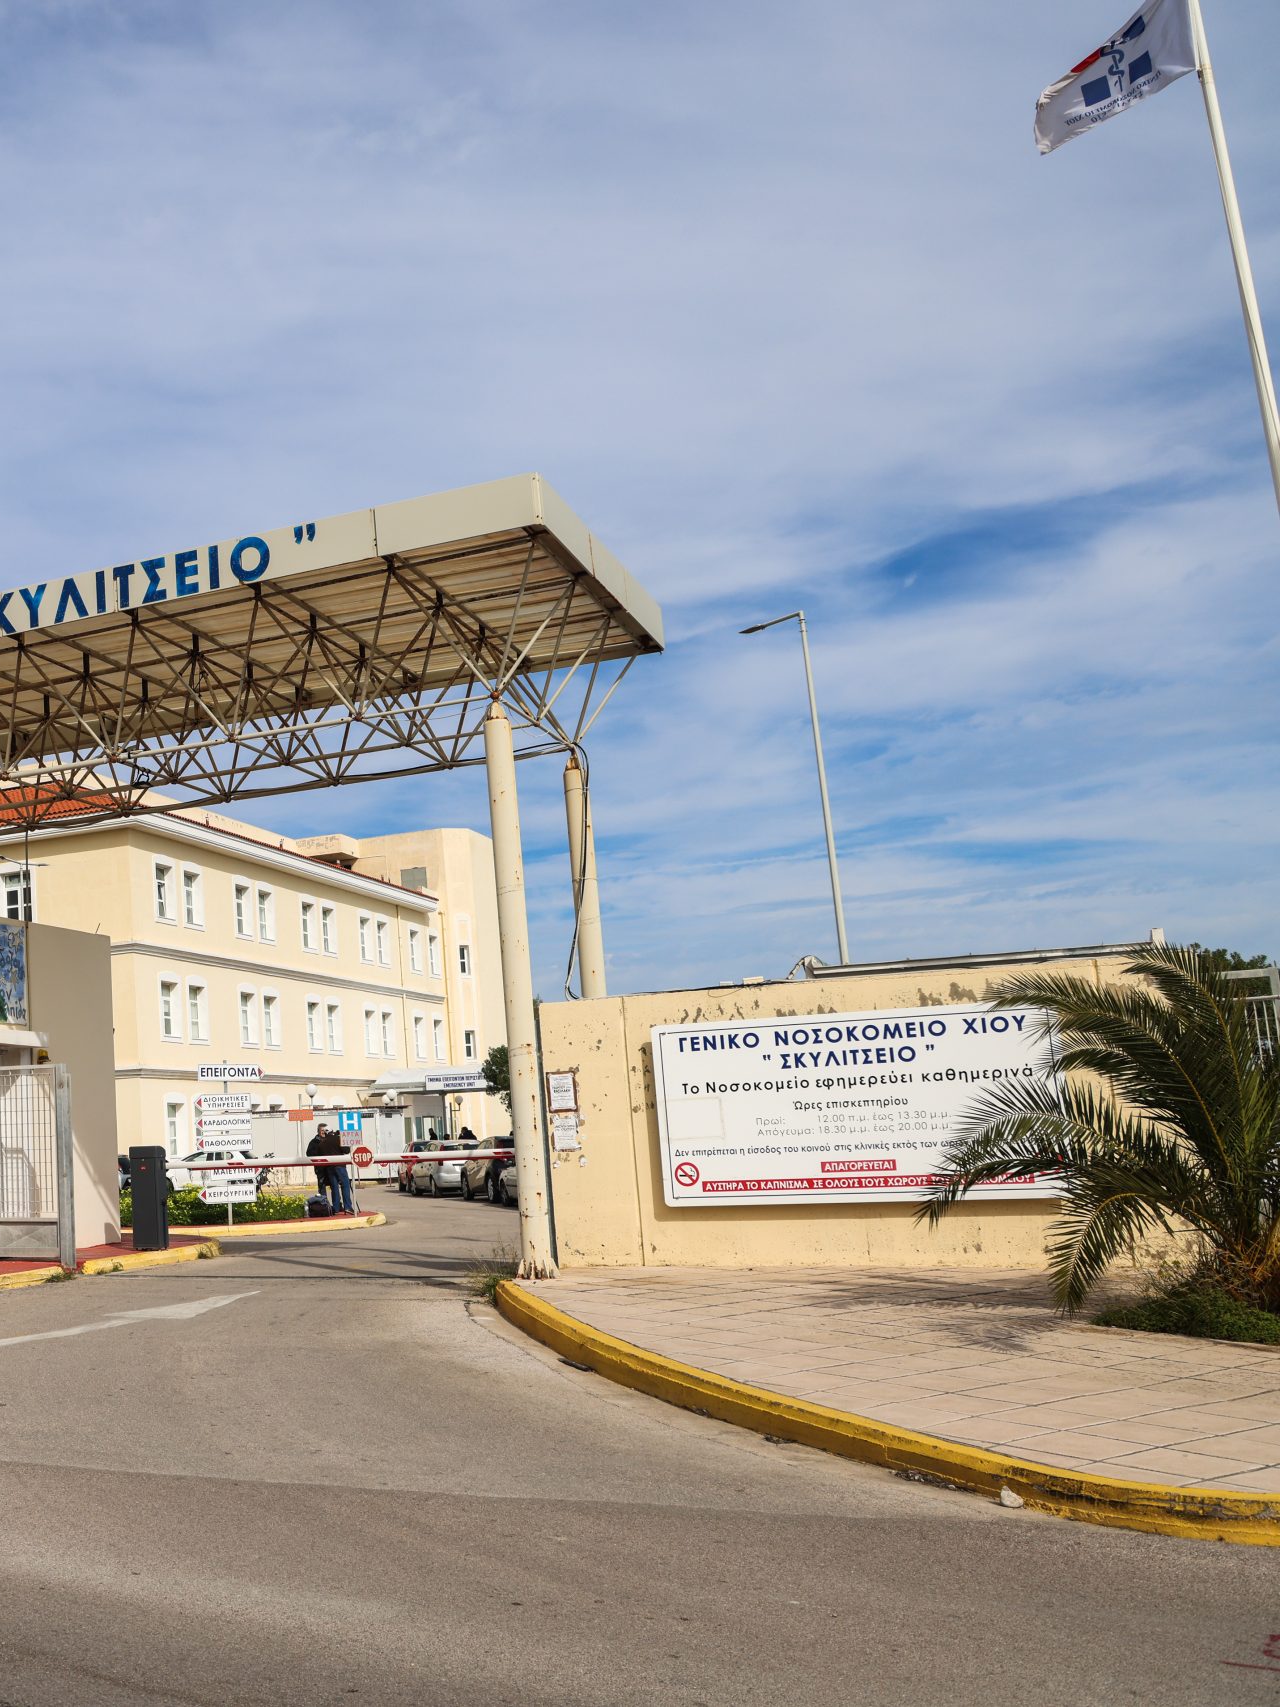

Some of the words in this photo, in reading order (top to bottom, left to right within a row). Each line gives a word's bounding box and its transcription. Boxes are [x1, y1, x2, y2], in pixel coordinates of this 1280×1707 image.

[679, 1032, 760, 1052] ΓΕΝΙΚΟ
[774, 1020, 946, 1046] ΝΟΣΟΚΟΜΕΙΟ
[962, 1015, 1026, 1035] ΧΙΟΥ
[200, 1067, 258, 1077] ΕΠΕΙΓΟΝΤΑ
[682, 1083, 700, 1095] Το
[706, 1076, 810, 1095] Νοσοκομείο
[815, 1070, 913, 1091] εφημερεύει
[921, 1063, 1033, 1085] καθημερινά
[826, 1096, 908, 1109] επισκεπτηρίου
[817, 1113, 845, 1123] 12.00
[873, 1112, 894, 1122] έως
[897, 1110, 927, 1120] 13.30
[818, 1125, 846, 1134] 18.30
[873, 1123, 894, 1133] έως
[898, 1121, 928, 1131] 20.00
[205, 1139, 251, 1147] ΠΑΘΟΛΟΓΙΚΗ
[675, 1149, 690, 1157] Δεν
[739, 1148, 745, 1156] η
[747, 1145, 781, 1155] είσοδος
[801, 1143, 831, 1152] κοινού
[834, 1143, 852, 1152] στις
[854, 1141, 890, 1151] κλινικές
[892, 1140, 917, 1150] εκτός
[354, 1154, 372, 1163] STOP
[824, 1161, 894, 1171] ΑΠΑΓΟΡΕΥΕΤΑΙ
[705, 1181, 744, 1191] ΑΥΣΤΗΡΑ
[746, 1181, 760, 1190] ΤΟ
[761, 1180, 809, 1190] ΚΑΠΝΙΣΜΑ
[813, 1179, 824, 1188] ΣΕ
[825, 1178, 860, 1188] ΟΛΟΥΣ
[861, 1177, 886, 1187] ΤΟΥΣ
[887, 1176, 928, 1186] ΧΩΡΟΥΣ
[208, 1190, 254, 1198] ΧΕΙΡΟΥΡΓΙΚΗ
